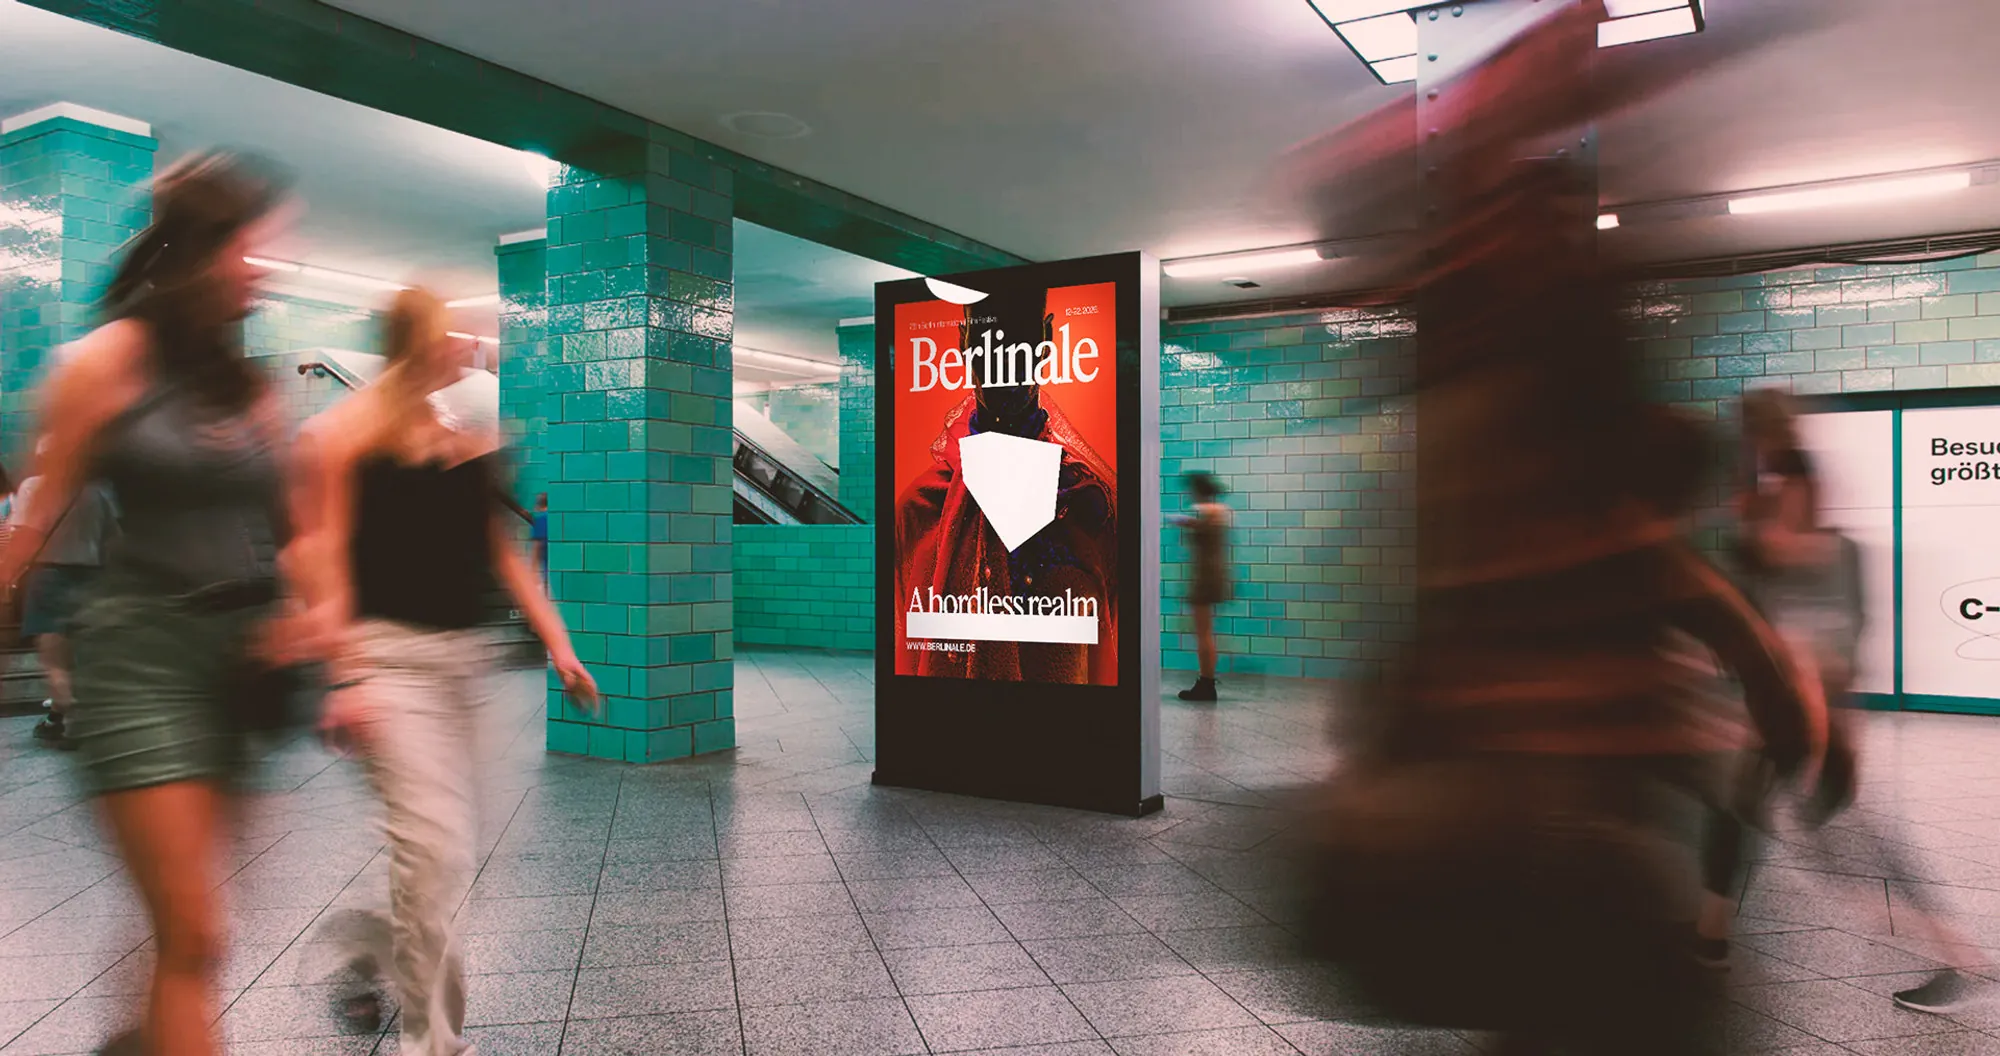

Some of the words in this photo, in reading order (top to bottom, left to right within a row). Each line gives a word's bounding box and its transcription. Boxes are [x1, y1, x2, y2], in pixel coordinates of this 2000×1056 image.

[909, 323, 1099, 392] Berlinale
[1931, 437, 2000, 456] Besu
[909, 586, 923, 612] A
[1028, 588, 1099, 617] realm
[906, 641, 976, 652] WWW.BERLINALE.DE
